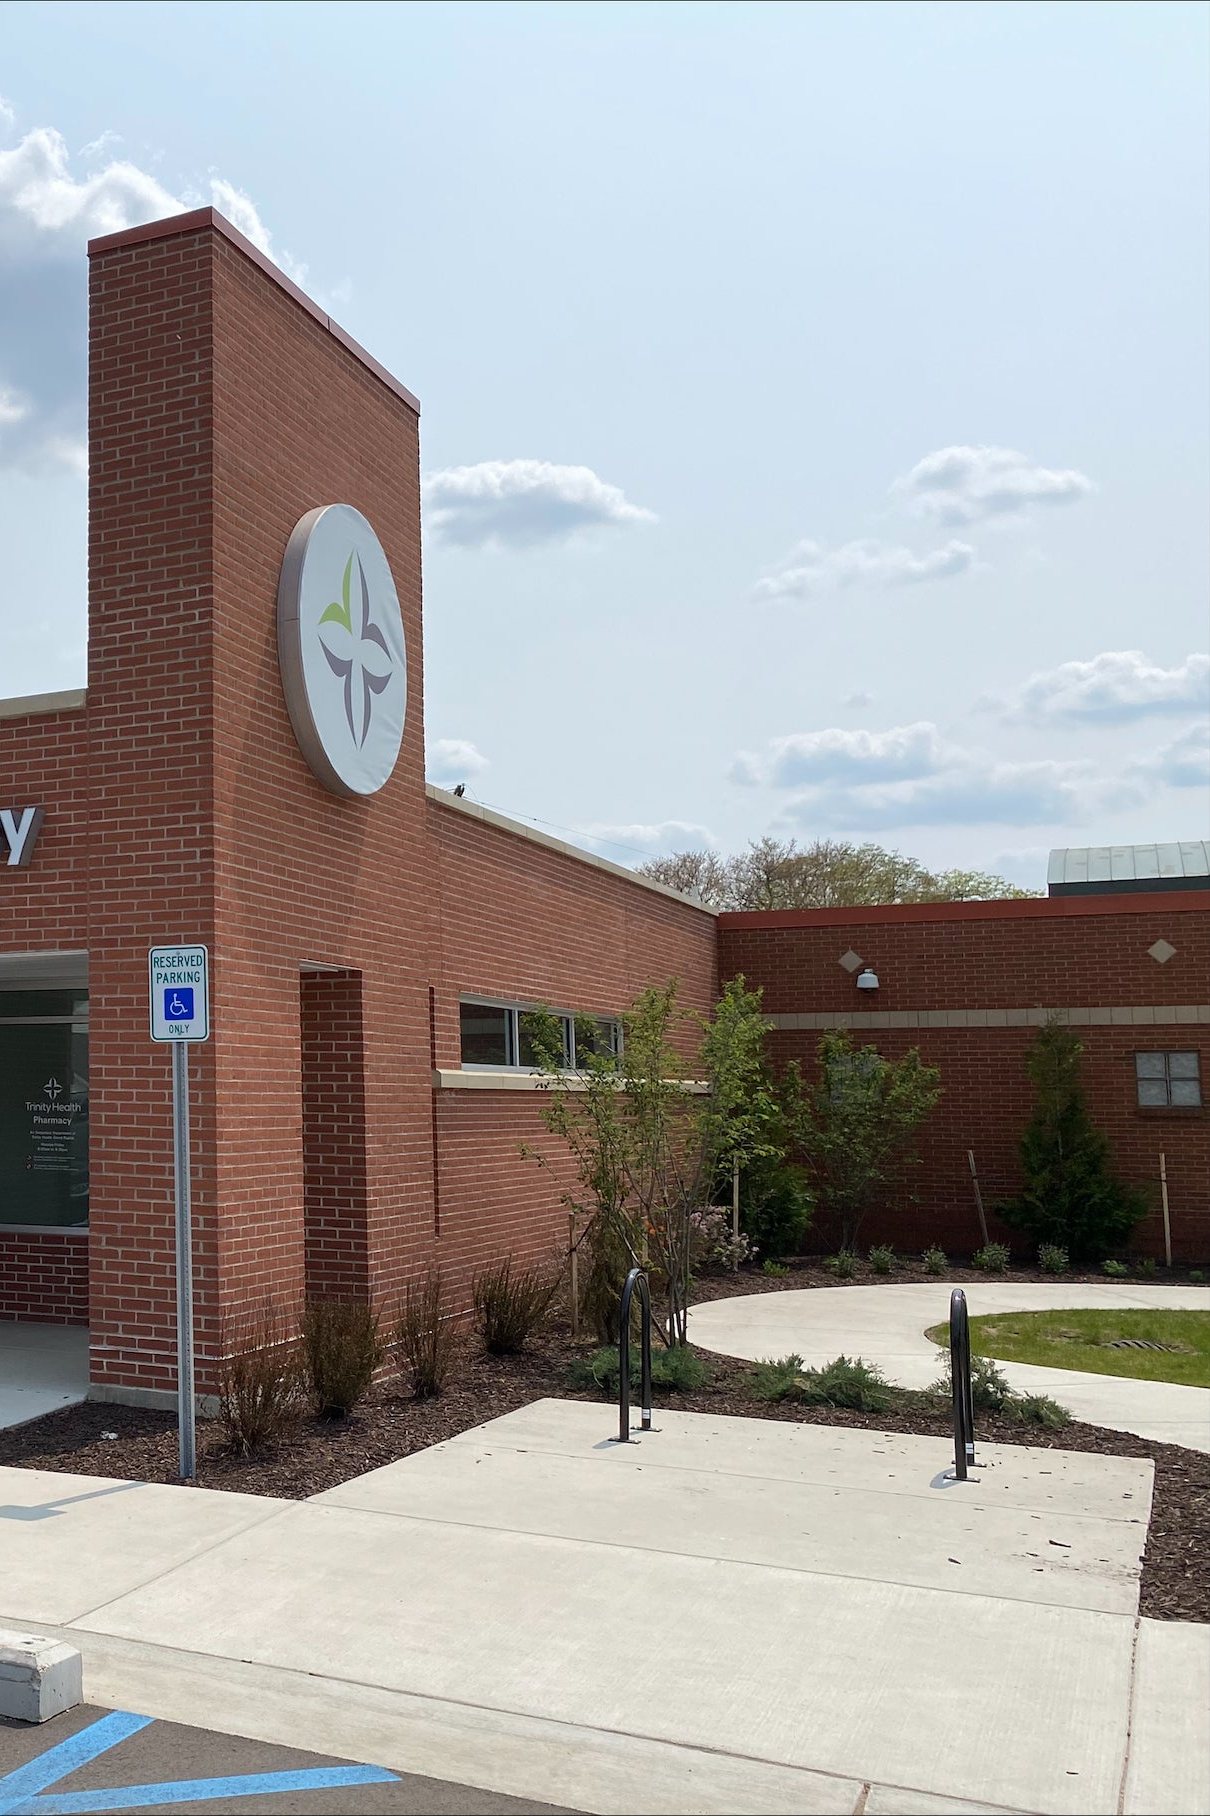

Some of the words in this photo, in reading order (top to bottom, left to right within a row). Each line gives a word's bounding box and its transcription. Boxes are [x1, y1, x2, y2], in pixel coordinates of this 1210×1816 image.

[154, 955, 202, 968] RESERVED
[156, 971, 200, 984] PARKING
[169, 1024, 190, 1033] ONLY
[25, 1102, 51, 1113] Trinity
[52, 1102, 81, 1112] Health
[33, 1115, 72, 1126] Pharmacy
